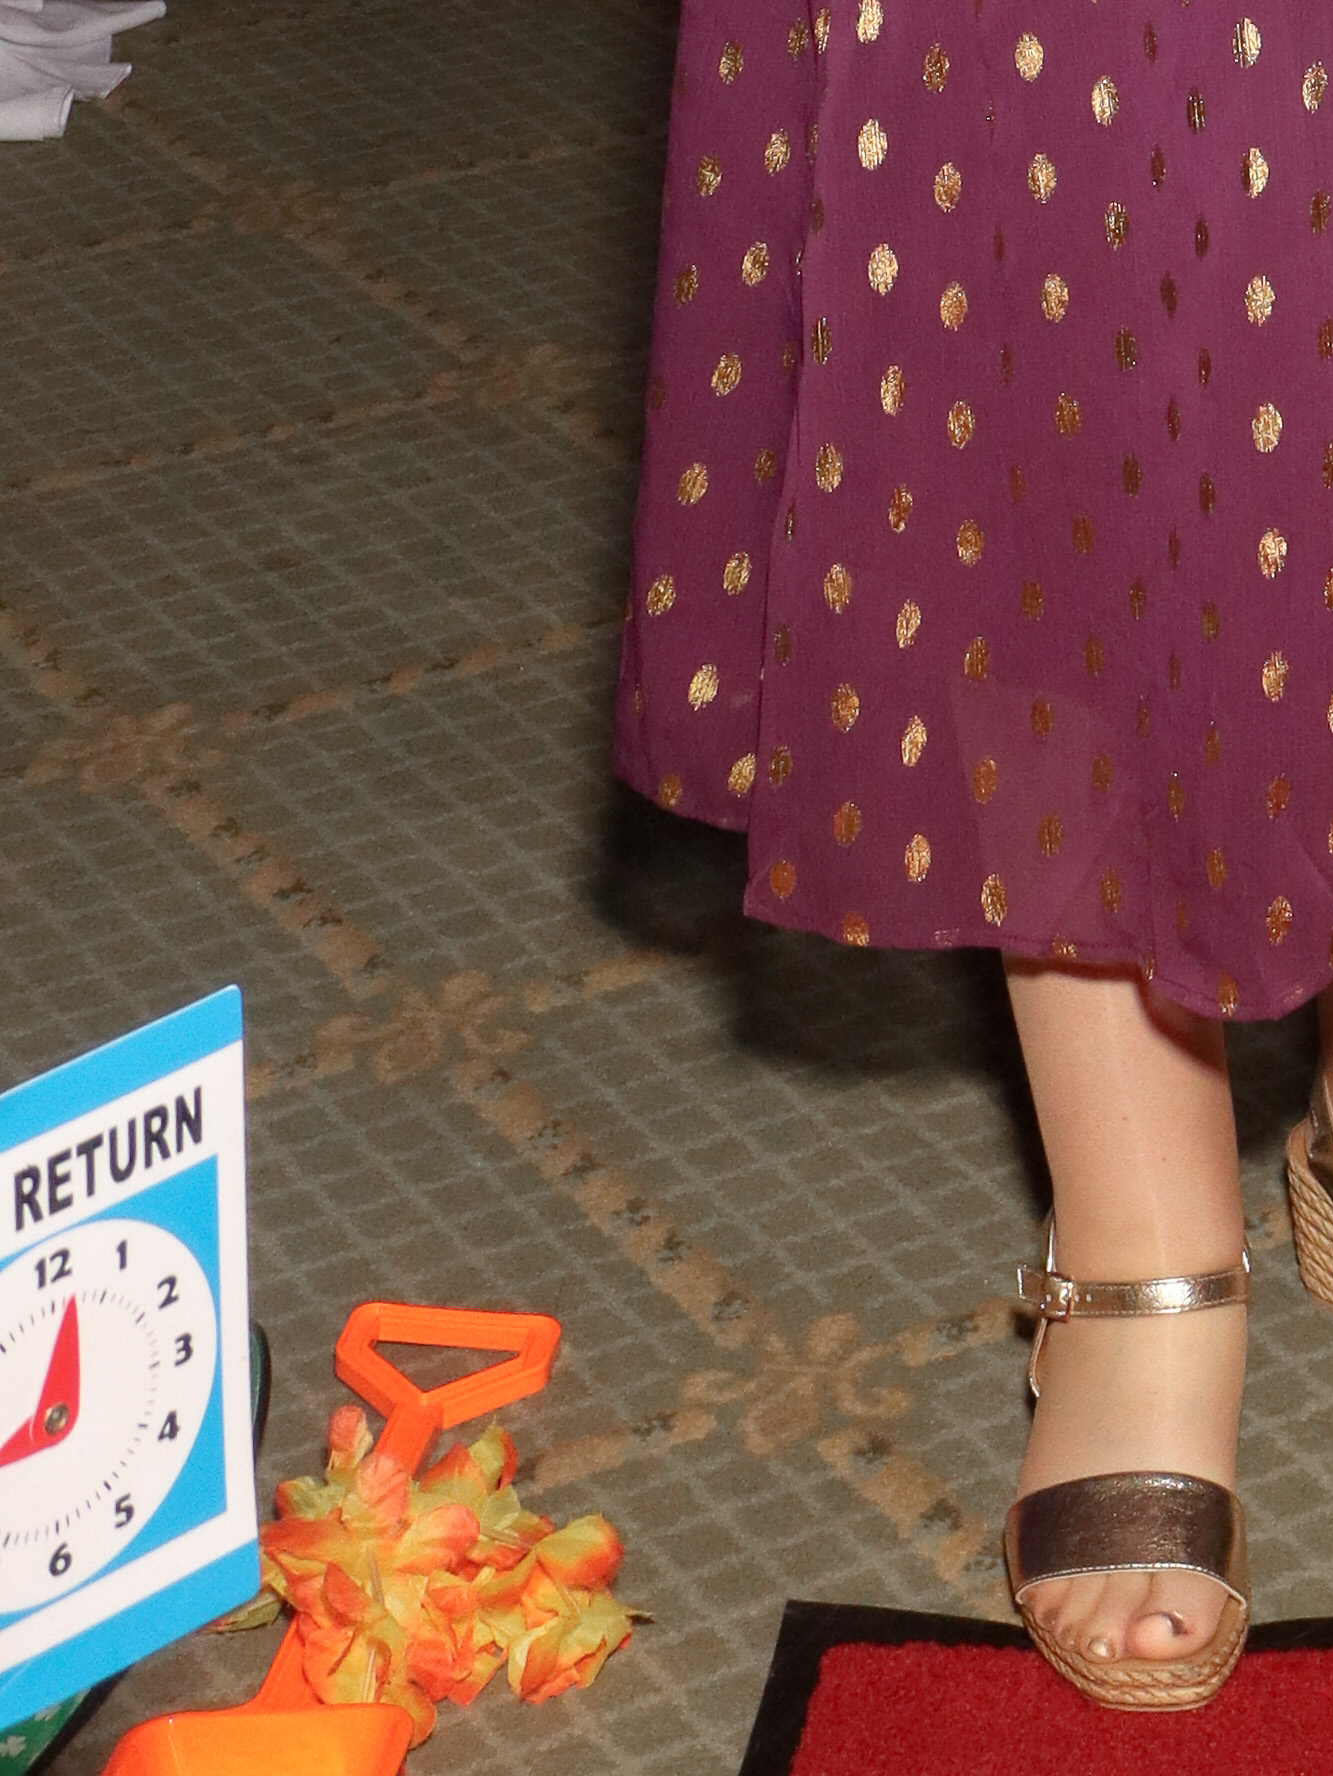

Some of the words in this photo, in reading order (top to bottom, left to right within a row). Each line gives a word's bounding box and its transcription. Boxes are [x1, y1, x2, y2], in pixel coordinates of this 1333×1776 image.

[14, 1086, 202, 1232] RETURN
[35, 1248, 72, 1289] 12
[116, 1239, 128, 1270] 1
[157, 1275, 179, 1310] 2
[174, 1332, 194, 1367] 3
[157, 1410, 180, 1441] 4
[114, 1494, 135, 1529] 5
[48, 1543, 73, 1577] 6
